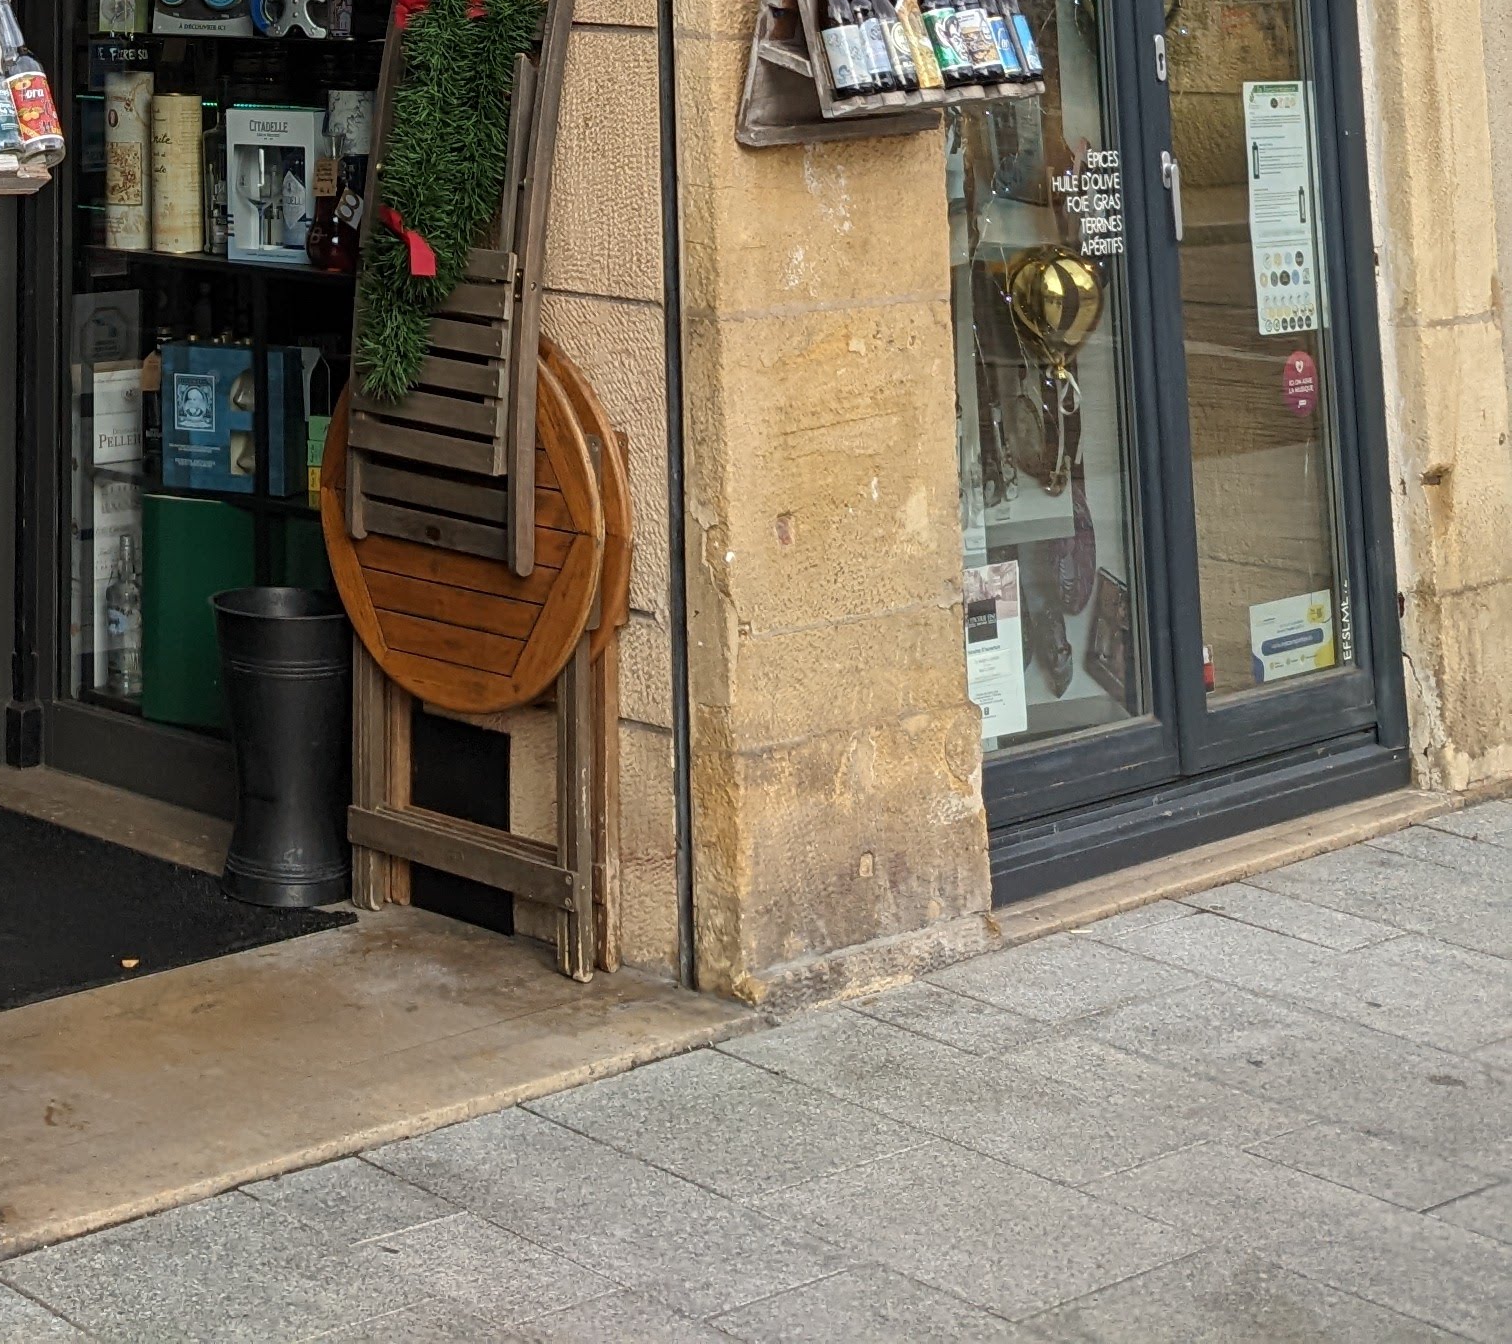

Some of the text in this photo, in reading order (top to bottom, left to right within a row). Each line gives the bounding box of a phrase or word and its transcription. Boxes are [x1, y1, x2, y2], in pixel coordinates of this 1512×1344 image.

[249, 119, 288, 133] CITADELLE
[1088, 149, 1119, 168] ÉPICES
[1052, 175, 1079, 192] HUILE
[1067, 193, 1121, 212] FOIE GRAS
[1080, 215, 1123, 234] TERRINES
[1080, 235, 1124, 256] APÉRITIFS
